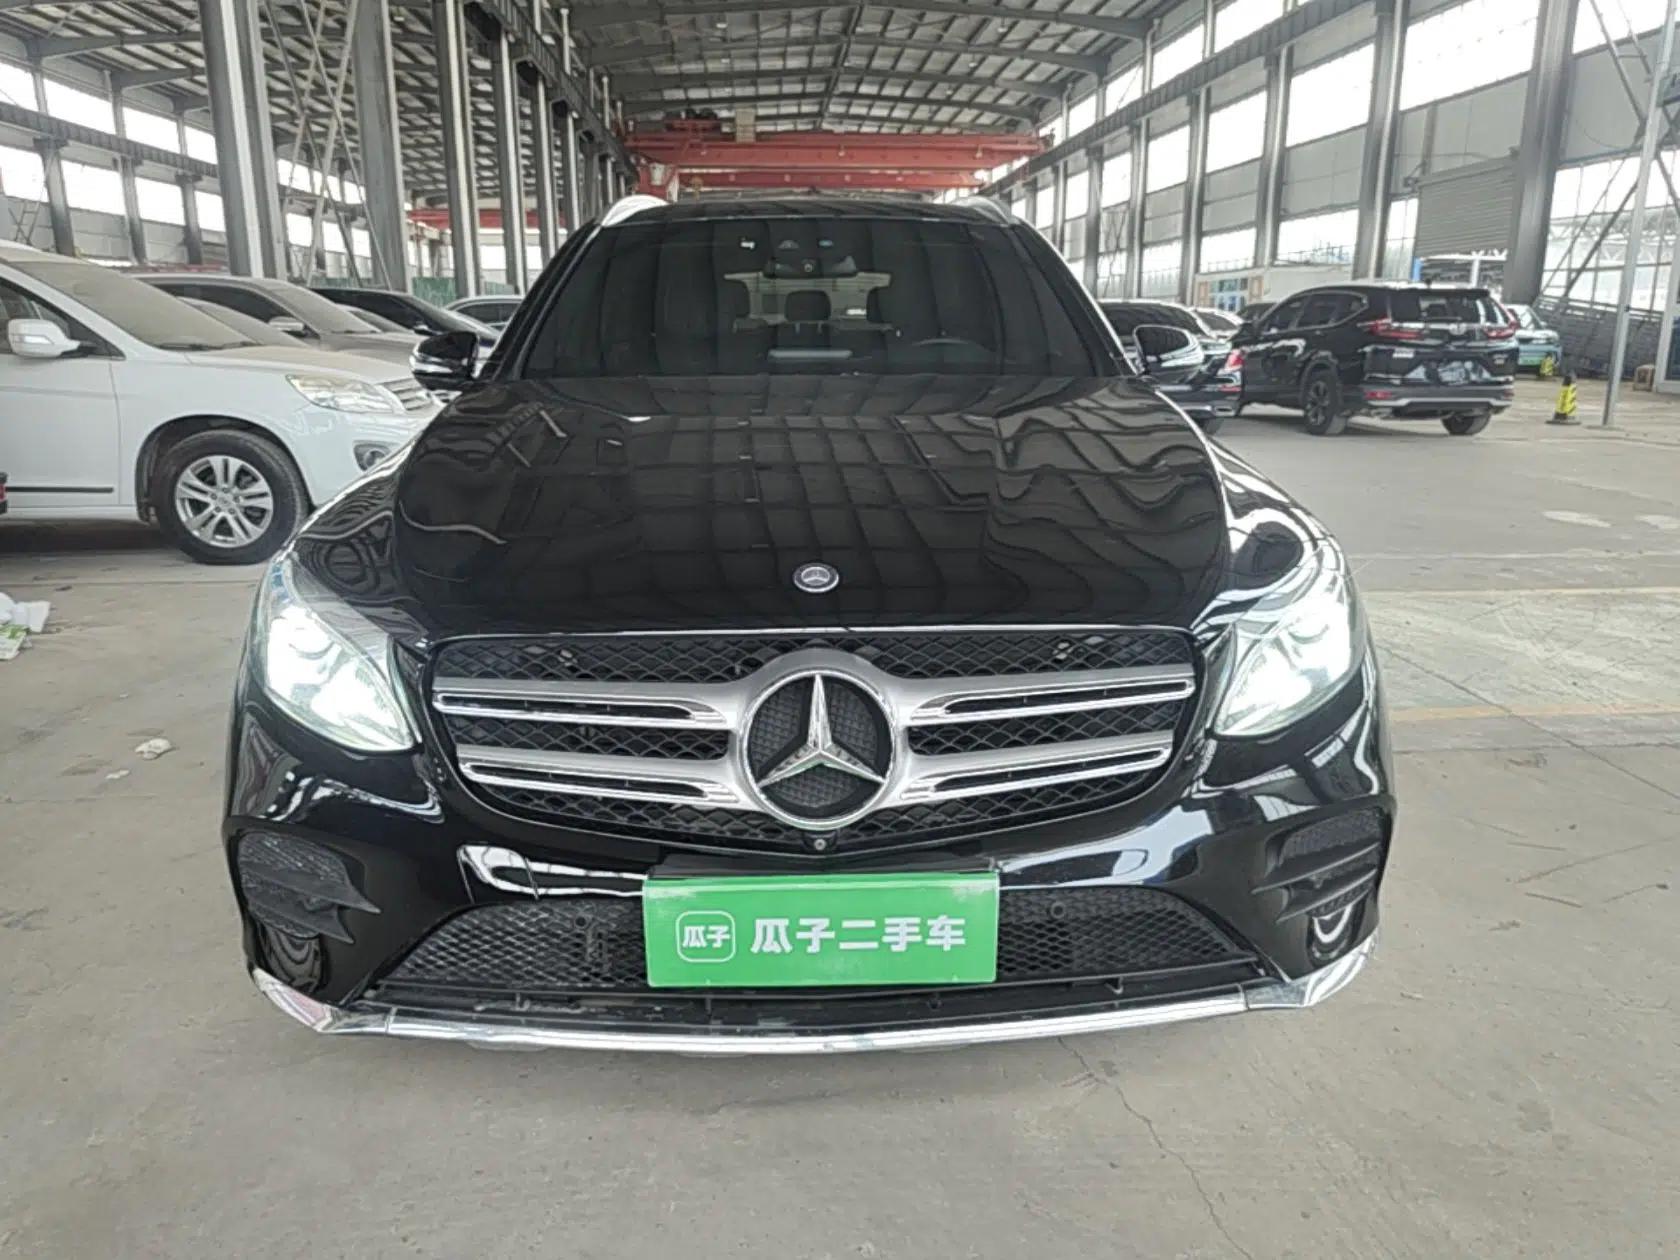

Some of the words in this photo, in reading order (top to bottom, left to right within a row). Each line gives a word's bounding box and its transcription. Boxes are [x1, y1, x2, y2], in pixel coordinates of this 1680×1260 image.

[682, 925, 731, 948] 瓜子
[751, 915, 966, 953] 瓜子二手车
